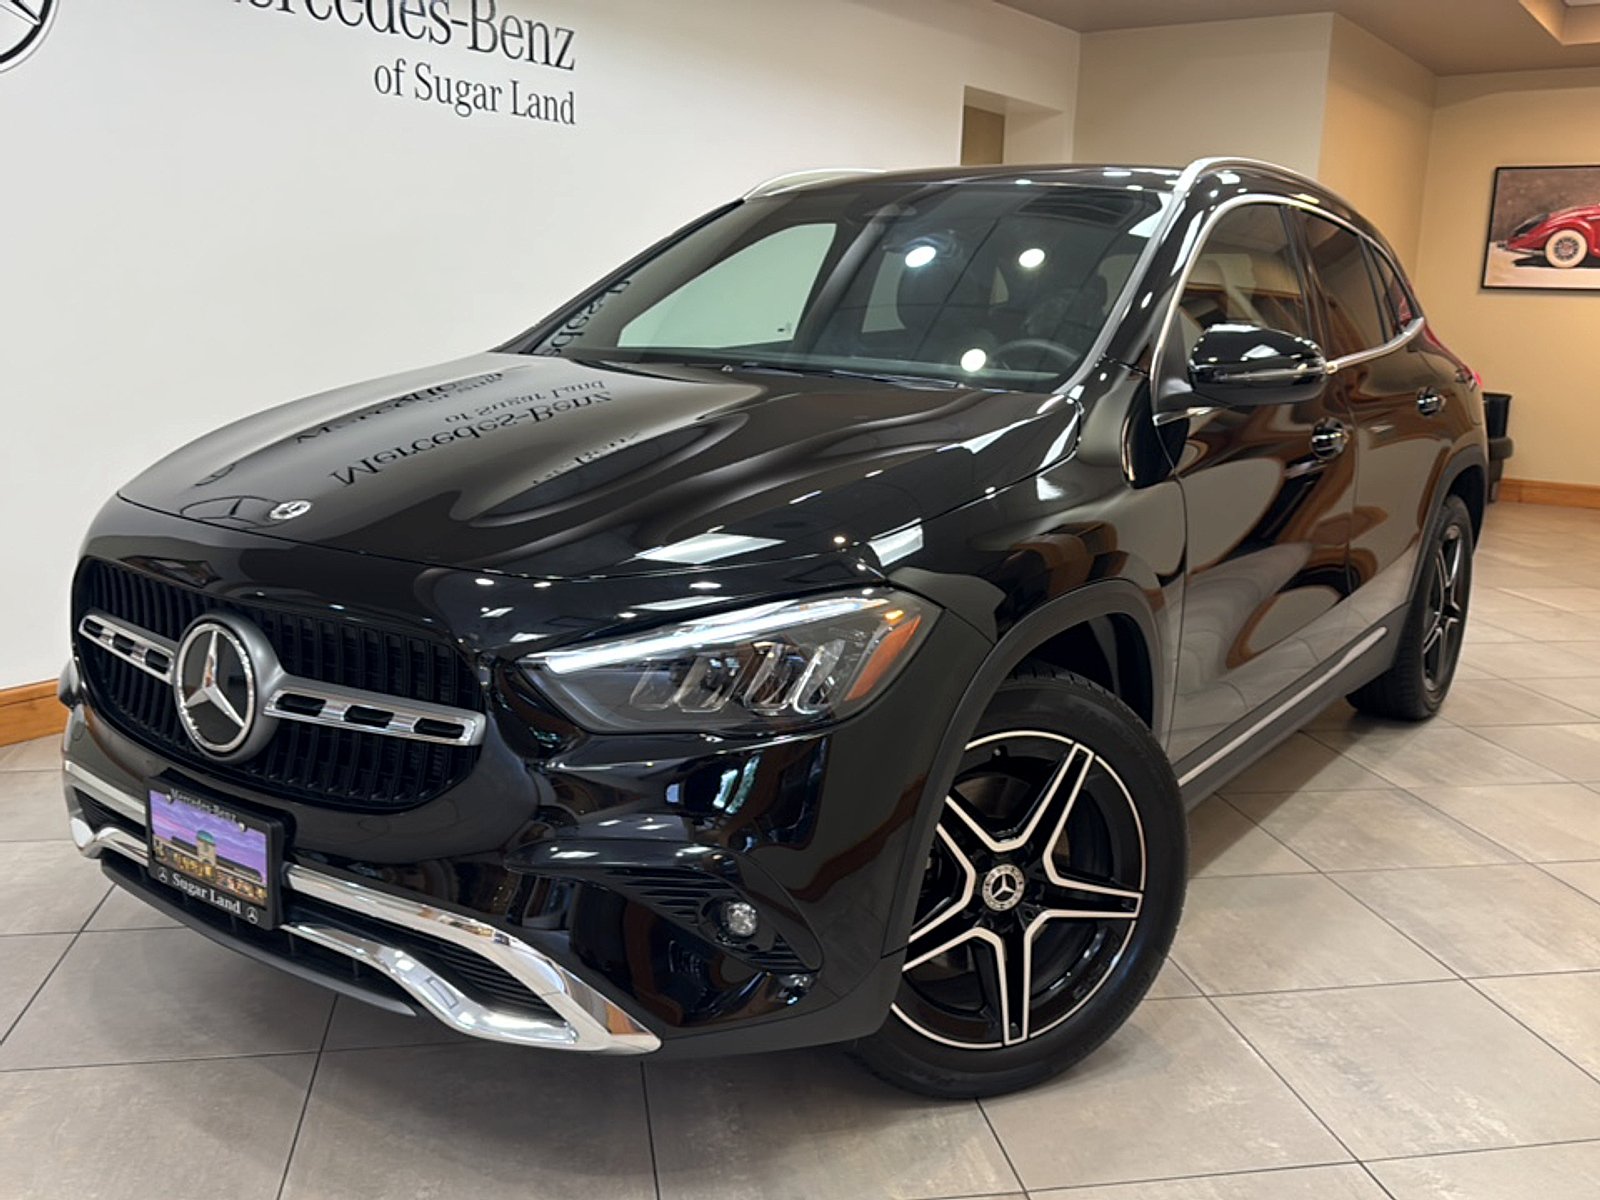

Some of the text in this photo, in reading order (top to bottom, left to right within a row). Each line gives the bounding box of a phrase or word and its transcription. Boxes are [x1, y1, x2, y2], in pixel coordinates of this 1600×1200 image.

[236, 0, 575, 71] edes-Benz
[373, 58, 575, 125] of Sugar Land
[171, 873, 242, 915] Sugar Land
